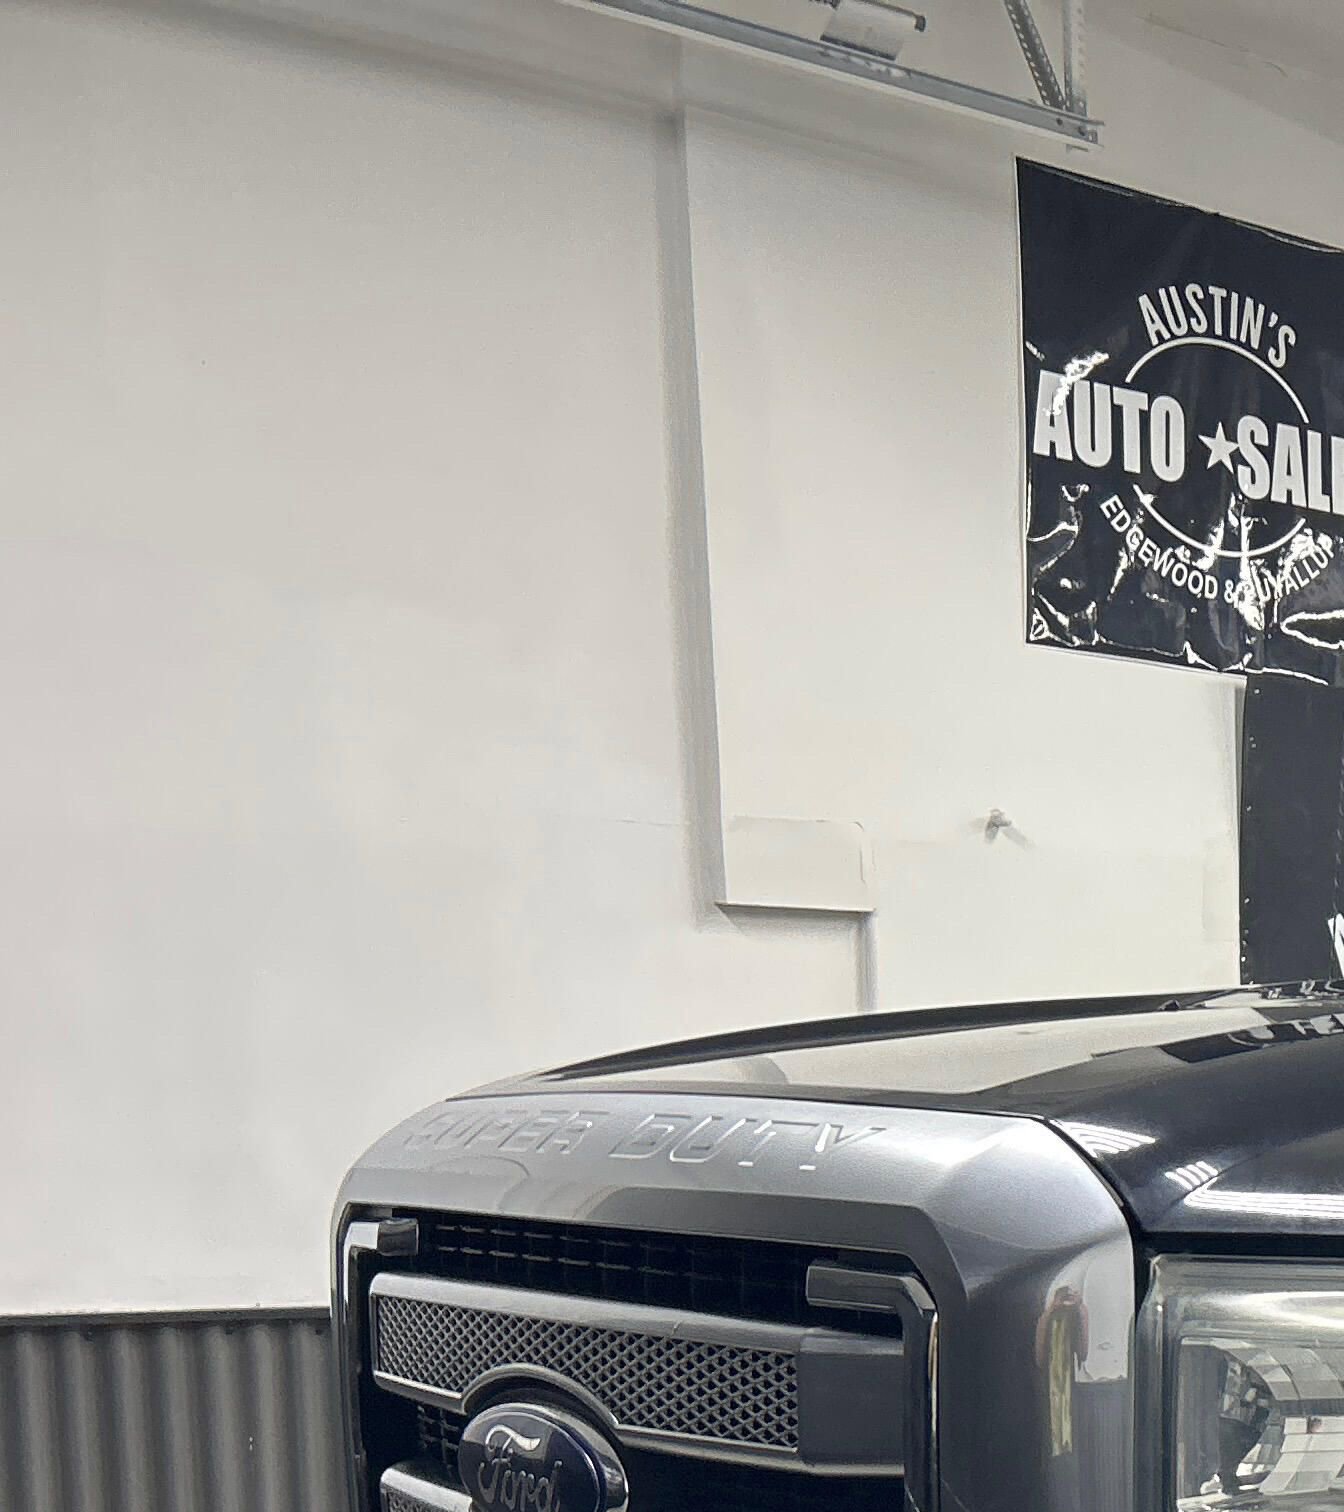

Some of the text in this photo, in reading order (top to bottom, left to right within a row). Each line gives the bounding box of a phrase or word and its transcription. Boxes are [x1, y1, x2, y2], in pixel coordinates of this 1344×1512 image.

[1137, 283, 1297, 368] AUSTIN'S
[1033, 370, 1186, 483] AUTO
[1100, 494, 1219, 601] EDGEWOOD
[608, 1112, 887, 1172] DUTY
